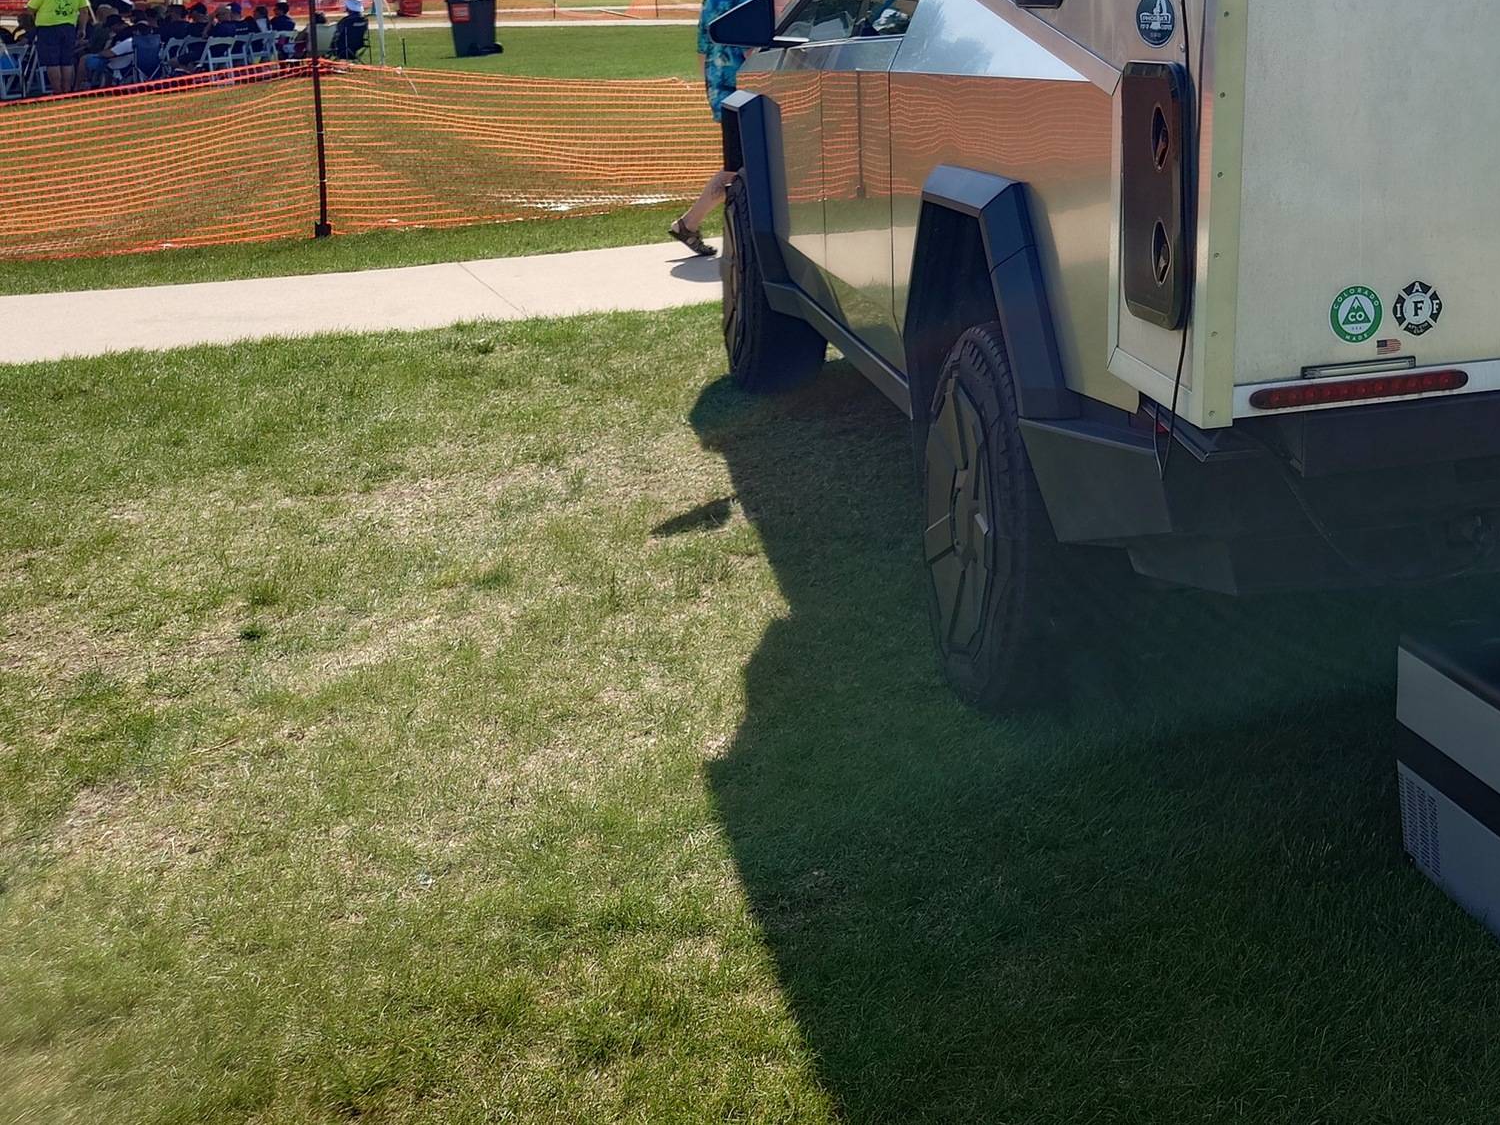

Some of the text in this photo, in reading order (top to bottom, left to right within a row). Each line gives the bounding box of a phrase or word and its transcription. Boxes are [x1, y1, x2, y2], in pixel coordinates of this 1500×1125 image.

[1333, 287, 1380, 309] COLORADO
[1412, 300, 1425, 317] F
[1348, 312, 1365, 322] CO
[1344, 333, 1369, 341] MADE
